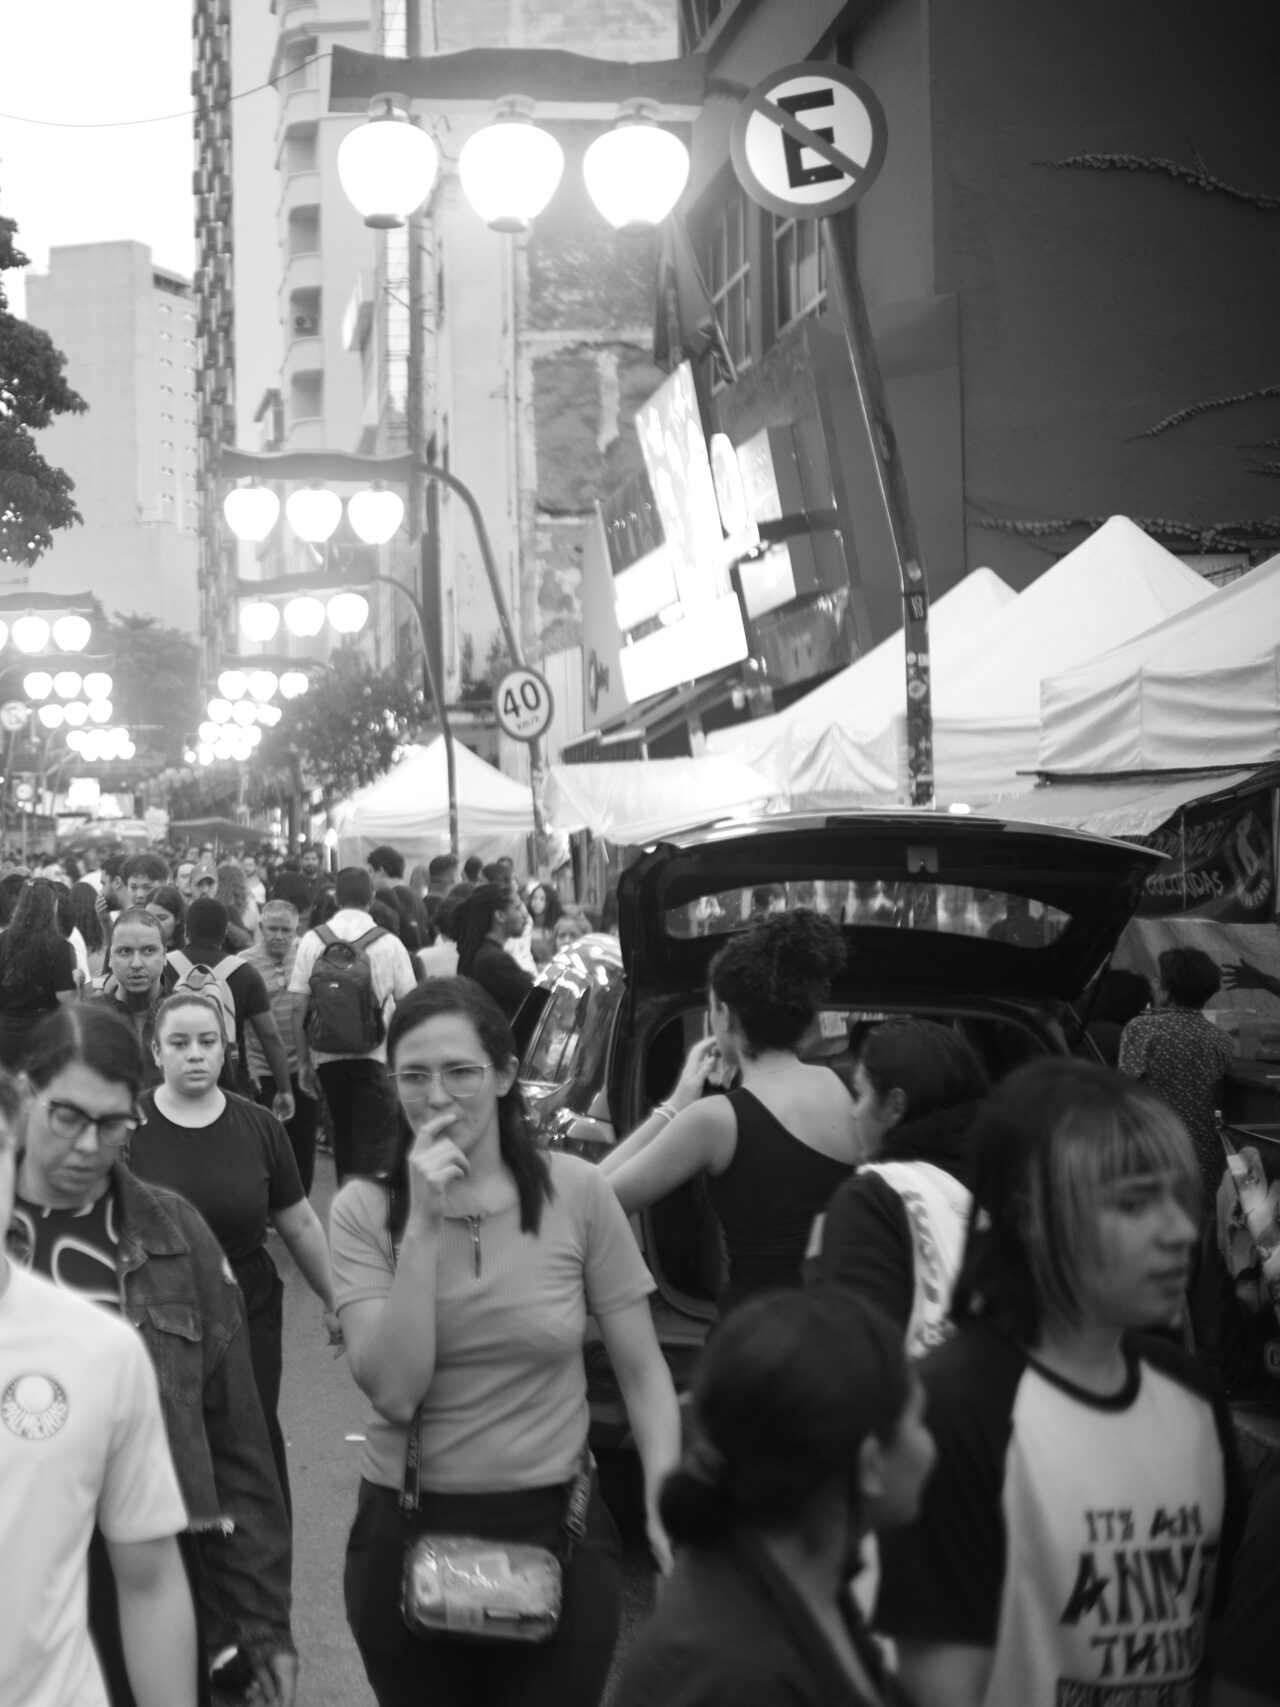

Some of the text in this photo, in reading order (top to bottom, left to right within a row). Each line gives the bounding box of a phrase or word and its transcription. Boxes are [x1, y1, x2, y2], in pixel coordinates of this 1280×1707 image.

[776, 87, 845, 189] E
[504, 679, 542, 718] 40
[516, 715, 542, 731] km/h
